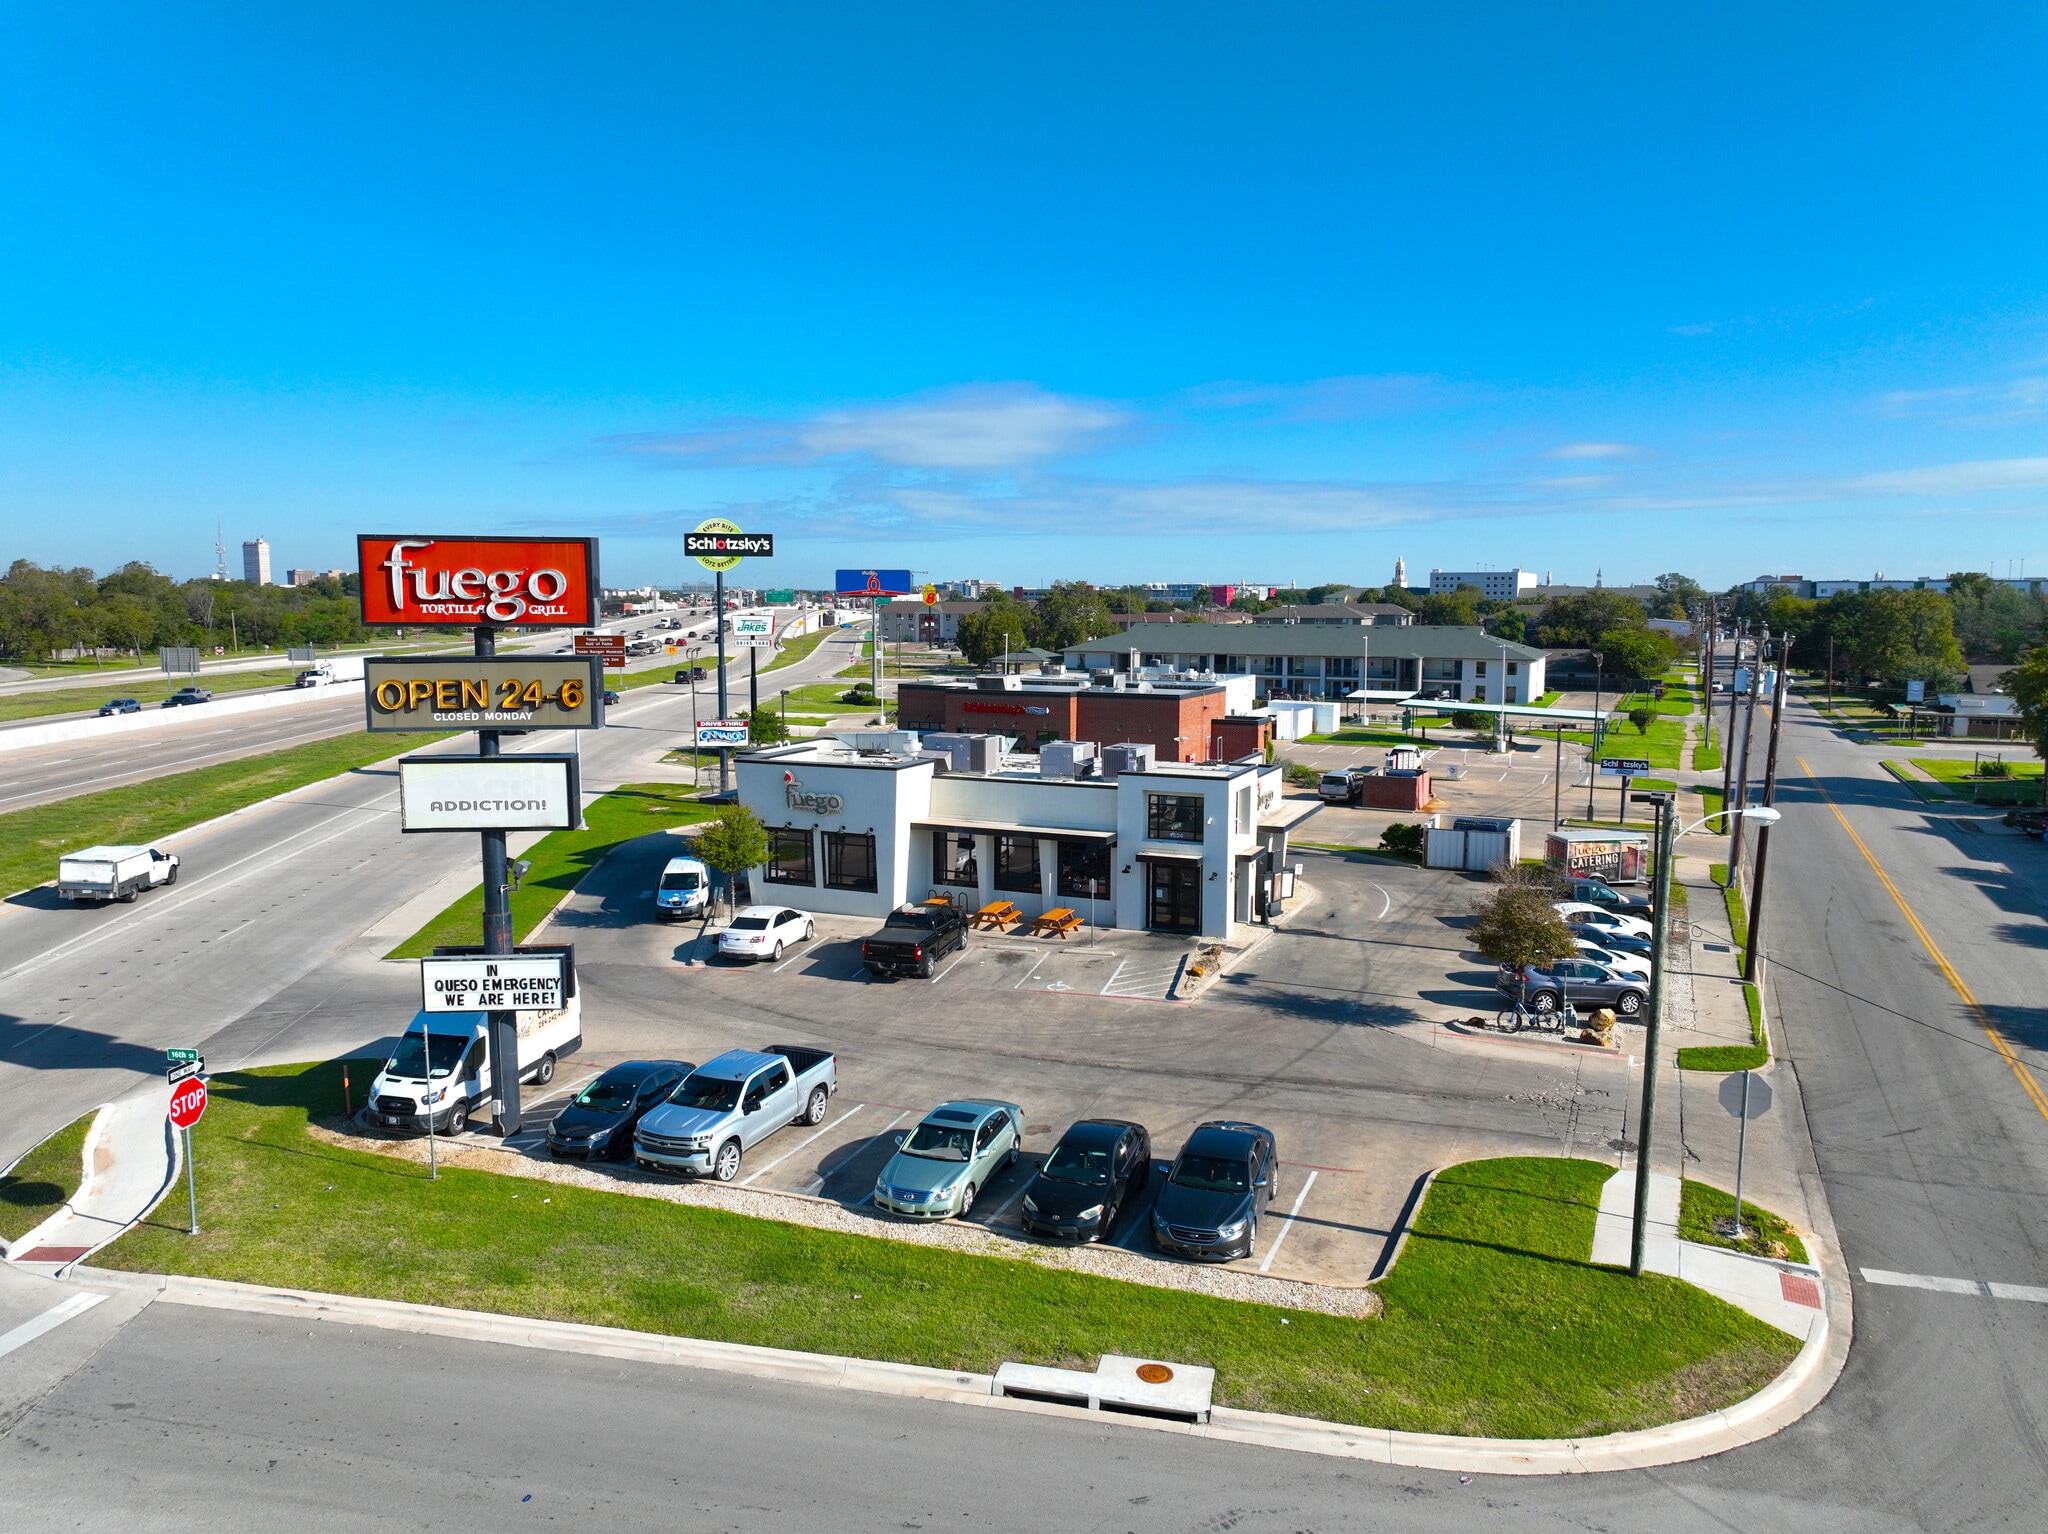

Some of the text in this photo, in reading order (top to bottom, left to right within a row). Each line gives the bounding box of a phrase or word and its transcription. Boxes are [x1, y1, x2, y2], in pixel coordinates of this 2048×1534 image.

[703, 522, 734, 532] EVERY BITE
[687, 536, 770, 552] Schlotzsky's
[702, 556, 735, 567] LOTZ BETTER
[384, 540, 567, 621] fuego
[867, 573, 880, 592] 6
[926, 592, 935, 603] 8
[420, 603, 568, 616] TORTILLA GRILL
[376, 679, 584, 710] OPEN 24-6
[434, 711, 533, 722] CLOSED MONDAY
[430, 799, 547, 811] ADDICTION!
[1574, 844, 1606, 857] fuego
[1571, 853, 1619, 869] CATERING
[486, 964, 498, 977] IN
[434, 977, 561, 992] QUESO EMERGENCY
[445, 992, 555, 1006] WE ARE HERE!
[171, 1051, 186, 1059] 16th
[172, 1065, 193, 1080] ONE WAY
[171, 1088, 204, 1118] STOP
